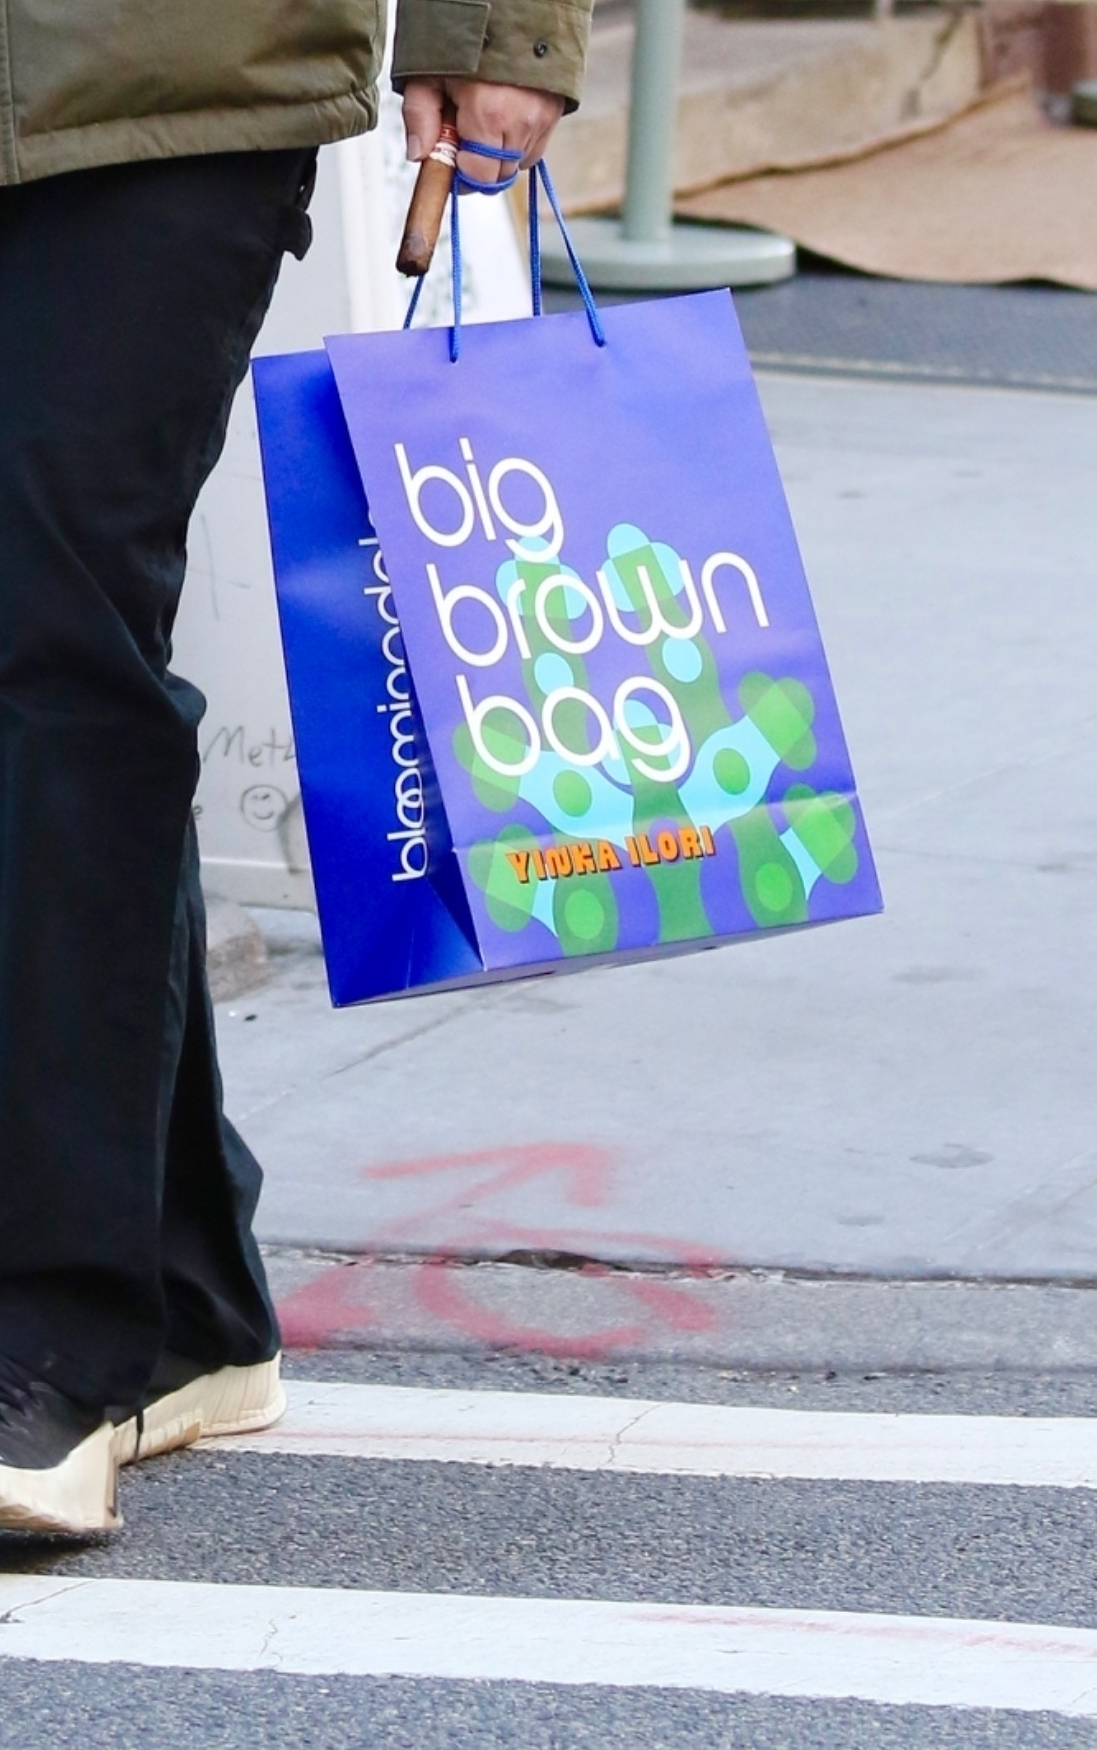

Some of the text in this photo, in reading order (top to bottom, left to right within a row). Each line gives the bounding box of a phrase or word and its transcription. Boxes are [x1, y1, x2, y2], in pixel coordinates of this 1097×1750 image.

[394, 437, 565, 563] big
[426, 552, 771, 667] brown
[358, 508, 429, 882] bloomindl
[455, 675, 692, 783] bag
[505, 825, 717, 884] YINKA ILORI
